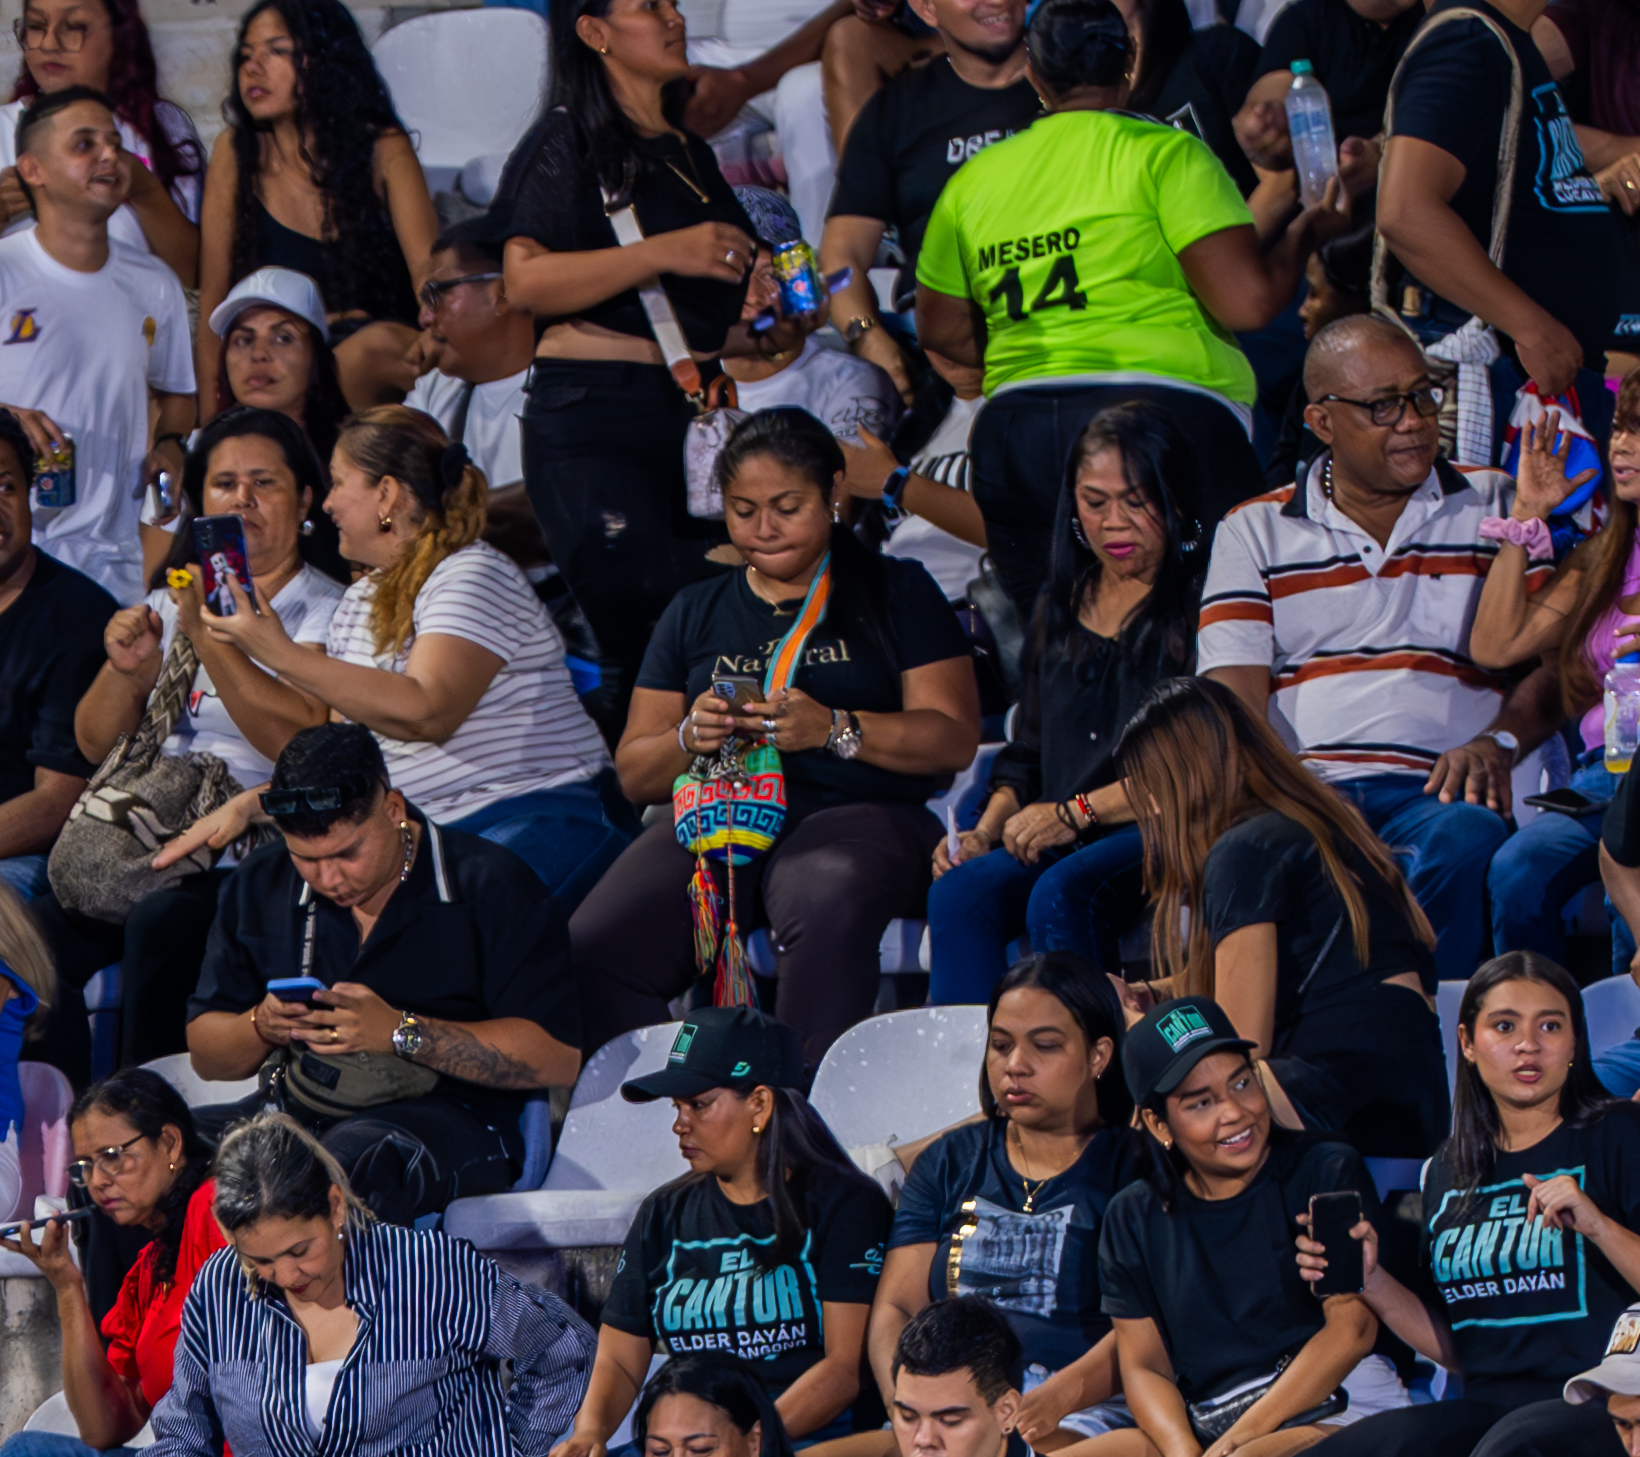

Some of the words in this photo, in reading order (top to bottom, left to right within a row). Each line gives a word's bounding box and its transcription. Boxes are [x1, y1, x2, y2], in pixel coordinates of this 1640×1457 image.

[978, 227, 1081, 272] MESERO
[989, 254, 1089, 321] 14
[1489, 1196, 1527, 1220] EL
[720, 1248, 755, 1275] EL
[1445, 1279, 1501, 1305] ELDER
[1504, 1270, 1567, 1298] DAYÁN
[669, 1333, 733, 1354] ELDER
[736, 1322, 807, 1347] DAYÁN
